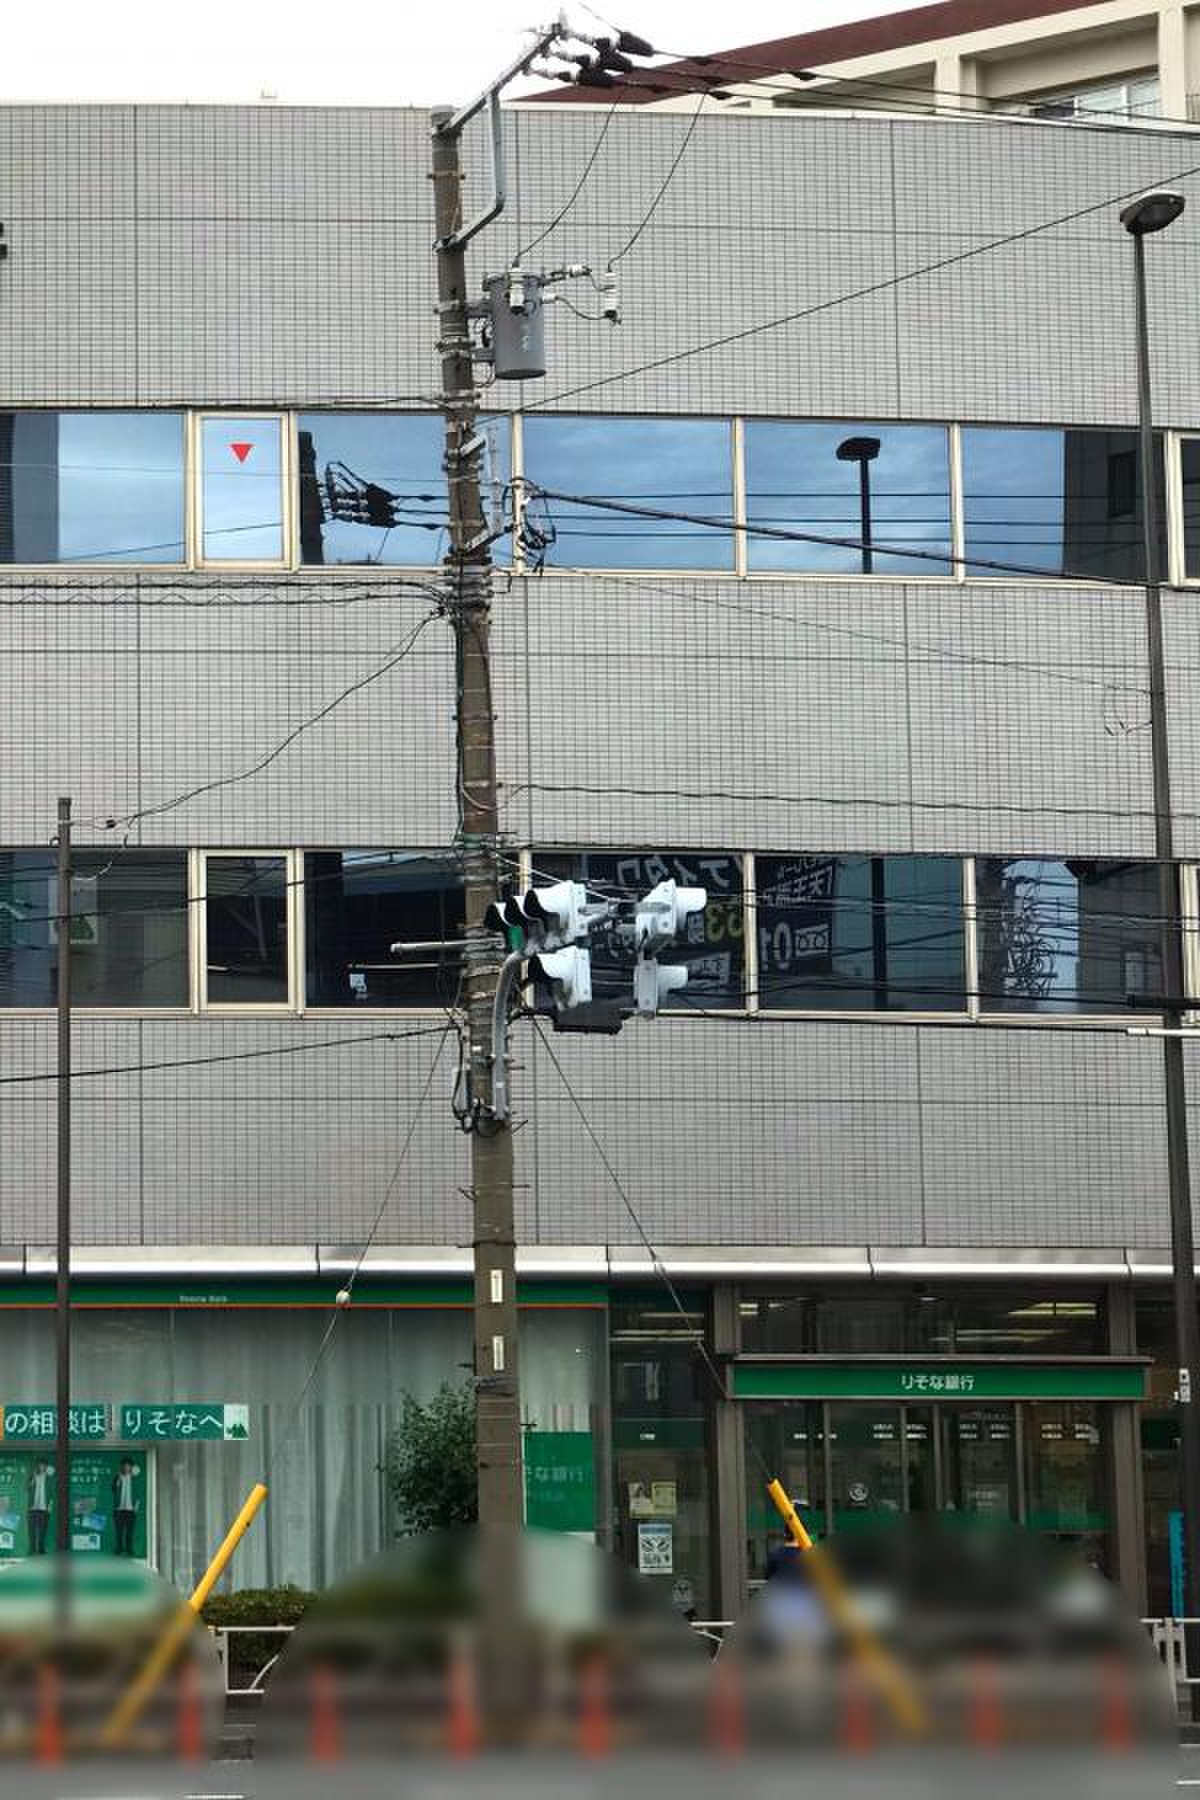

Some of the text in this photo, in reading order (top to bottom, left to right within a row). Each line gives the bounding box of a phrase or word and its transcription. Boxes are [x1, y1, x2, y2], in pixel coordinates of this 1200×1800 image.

[901, 1374, 975, 1391] りそな銀行
[125, 1409, 224, 1435] りそなへ
